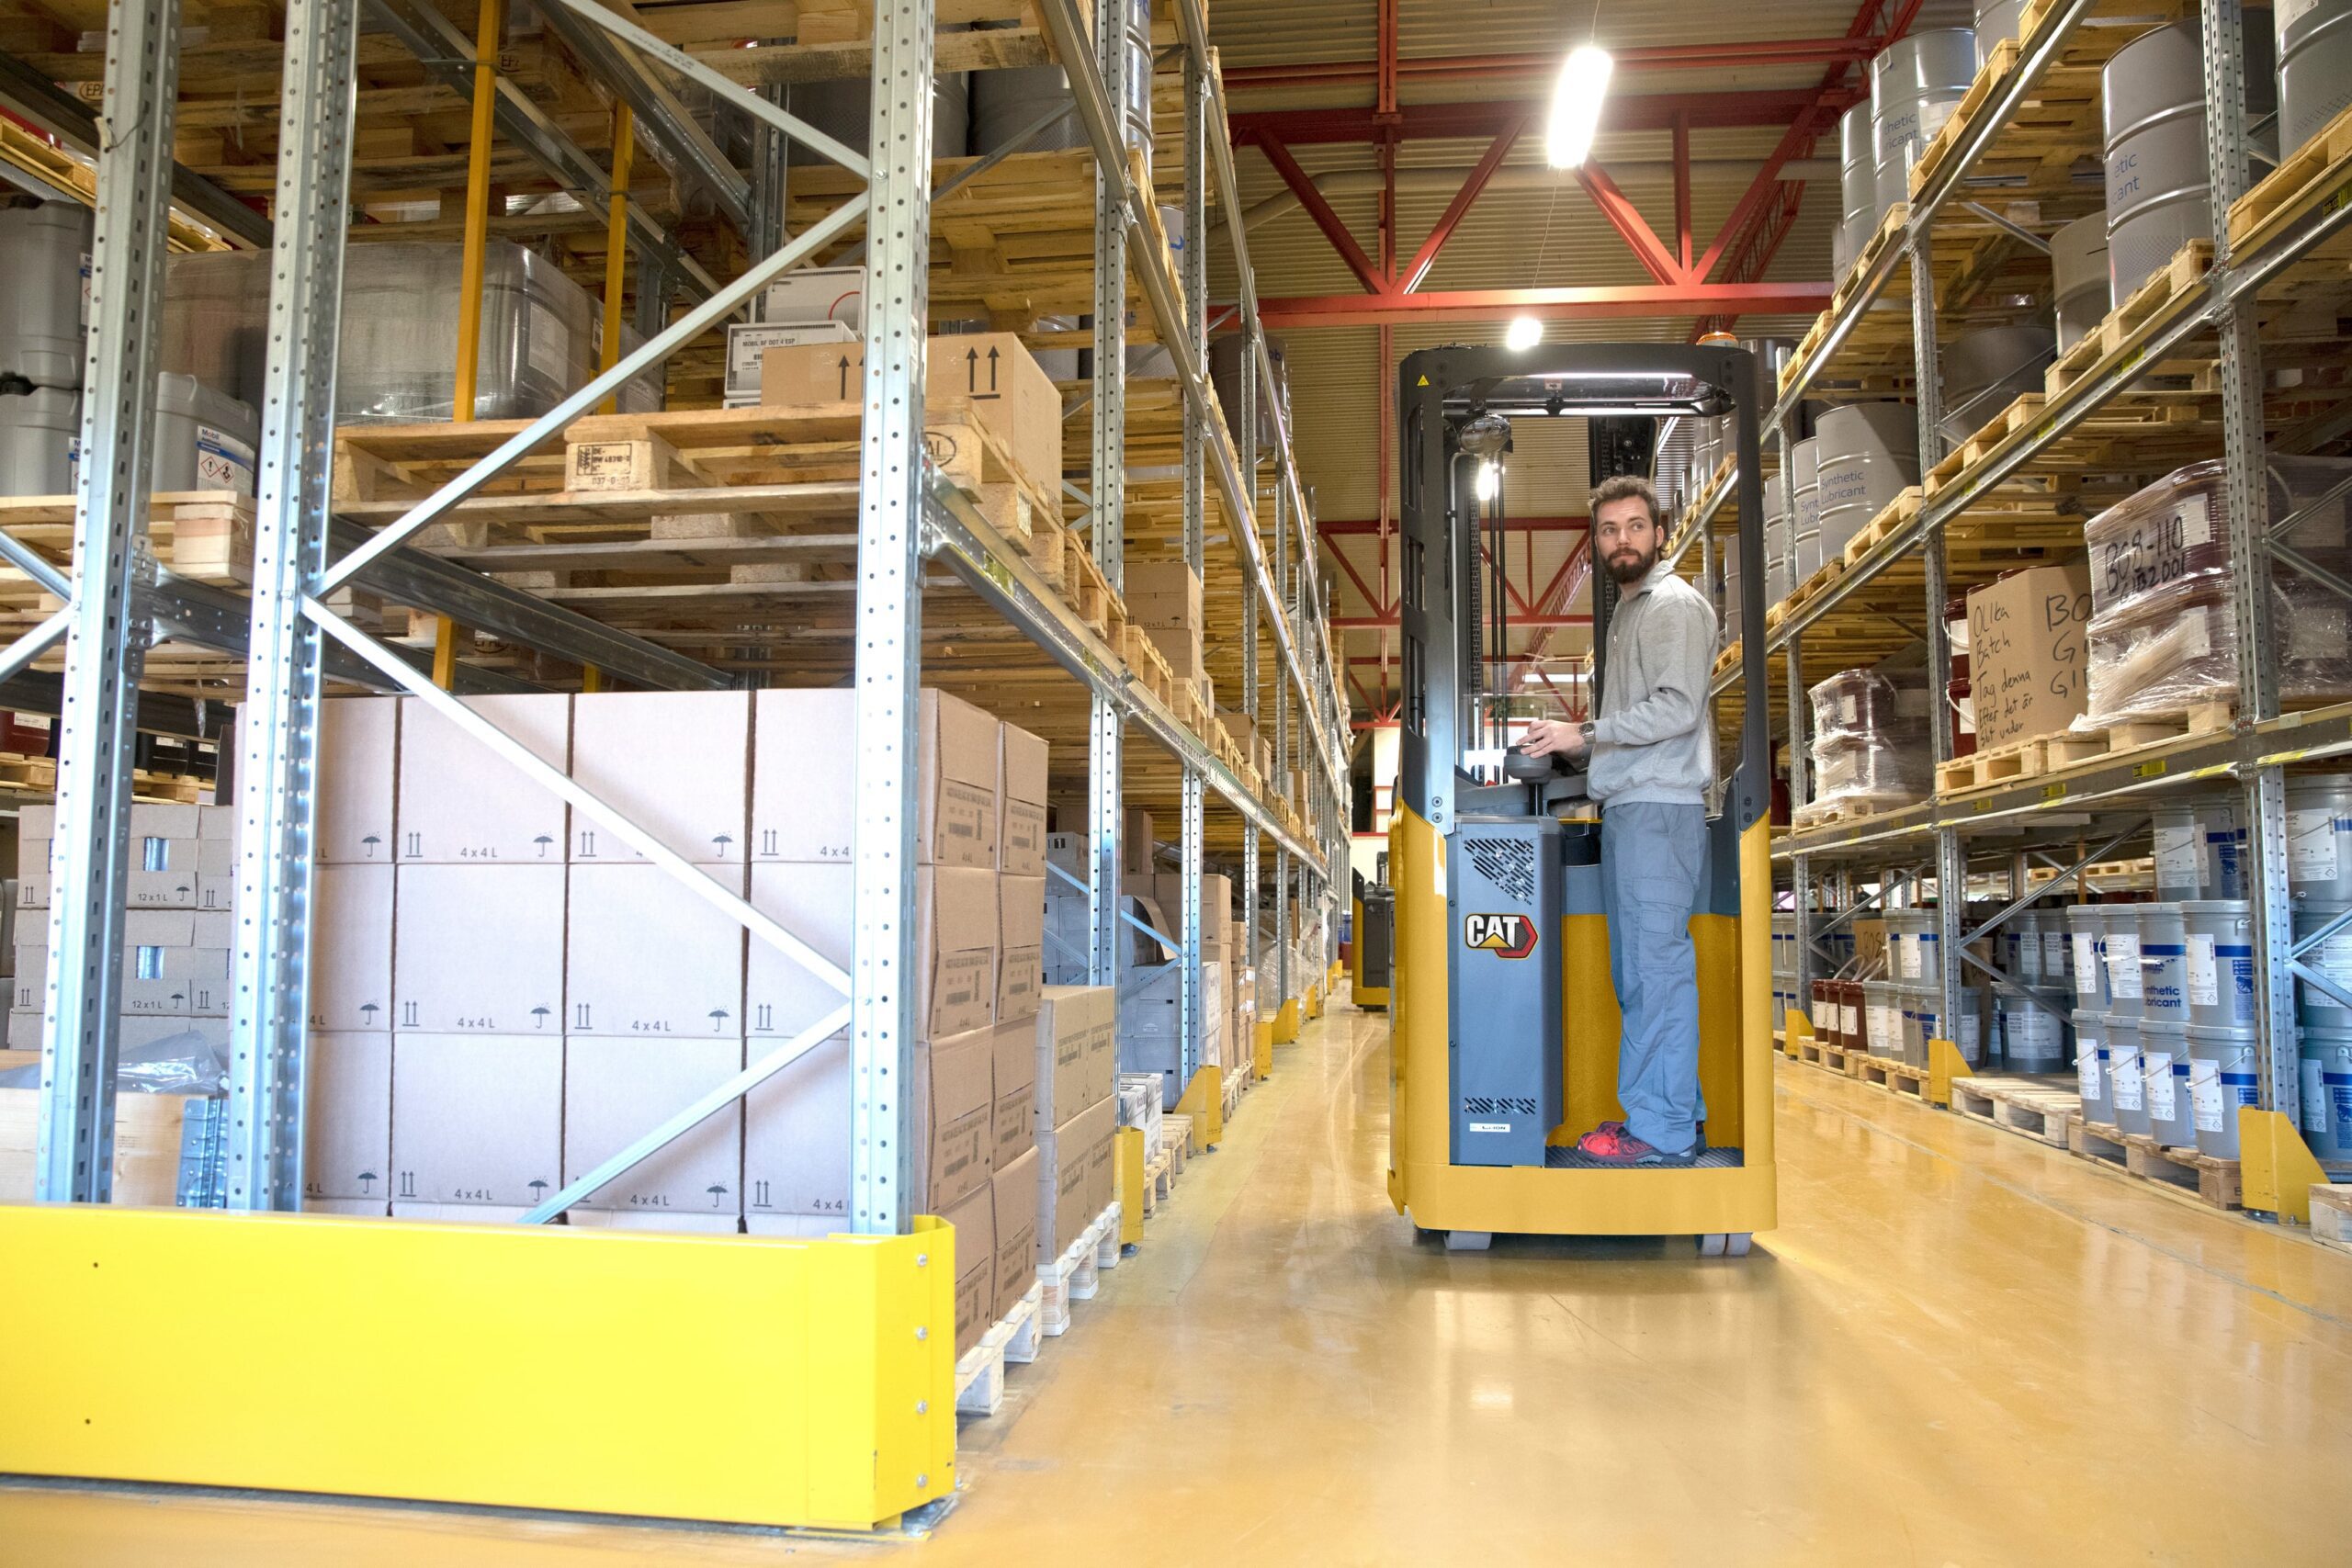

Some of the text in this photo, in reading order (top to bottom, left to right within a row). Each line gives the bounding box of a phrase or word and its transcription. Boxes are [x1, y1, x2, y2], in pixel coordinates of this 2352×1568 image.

[201, 428, 220, 440] Mobil
[1821, 470, 1864, 490] Synthetic
[1821, 486, 1866, 505] Lubricant
[1801, 499, 1819, 513] Synt
[1801, 513, 1820, 525] Lubr
[2046, 593, 2093, 632] B0
[1977, 629, 2011, 671] Batch
[1976, 668, 2031, 708] Tag denna
[2004, 697, 2018, 718] det
[1999, 719, 2024, 739] under
[461, 848, 468, 858] 4
[481, 848, 487, 858] 4
[492, 848, 498, 858] L
[820, 847, 827, 856] 4
[842, 847, 849, 856] 4
[1466, 915, 1521, 948] CAT
[132, 1000, 141, 1009] 12
[310, 1015, 325, 1025] 4 L
[458, 1018, 464, 1027] 4
[478, 1018, 484, 1028] 4
[489, 1019, 495, 1029] L
[632, 1021, 639, 1031] 4
[653, 1021, 661, 1031] 4
[664, 1021, 671, 1032] L
[306, 1182, 322, 1193] 4 L
[455, 1189, 461, 1199] 4
[476, 1189, 482, 1200] 4
[487, 1190, 492, 1200] L
[630, 1194, 638, 1204] 4
[651, 1195, 659, 1205] 4
[663, 1196, 670, 1206] L
[813, 1200, 820, 1210] 4
[835, 1200, 842, 1211] 4
